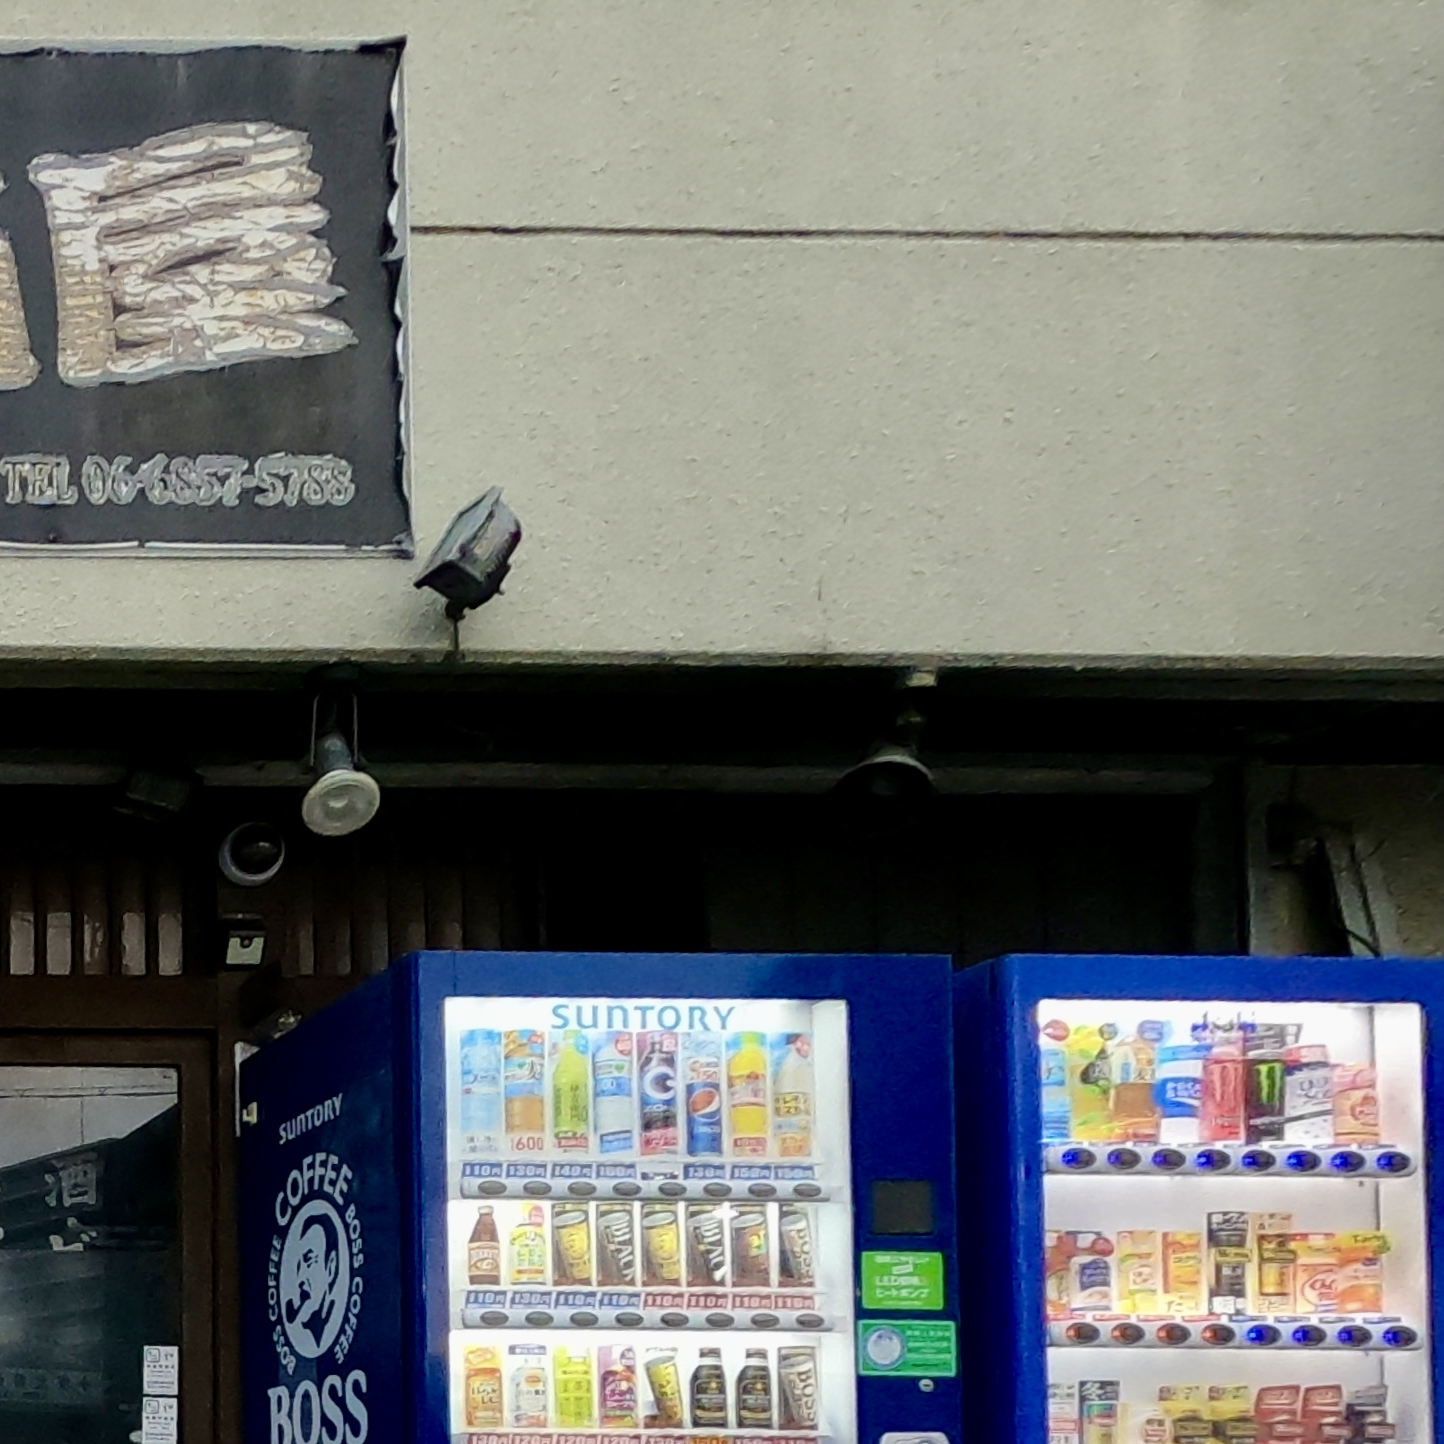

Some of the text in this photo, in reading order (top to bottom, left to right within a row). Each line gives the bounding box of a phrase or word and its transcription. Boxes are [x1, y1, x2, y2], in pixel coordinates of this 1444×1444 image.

[80, 450, 356, 507] 06-6857-5788
[550, 1003, 736, 1033] SUNTORY
[278, 1093, 344, 1145] SUNTORY
[275, 1152, 353, 1226] COFFEE
[267, 1234, 297, 1376] BOSS COFFEE
[333, 1203, 365, 1365] BOSS COFFEE
